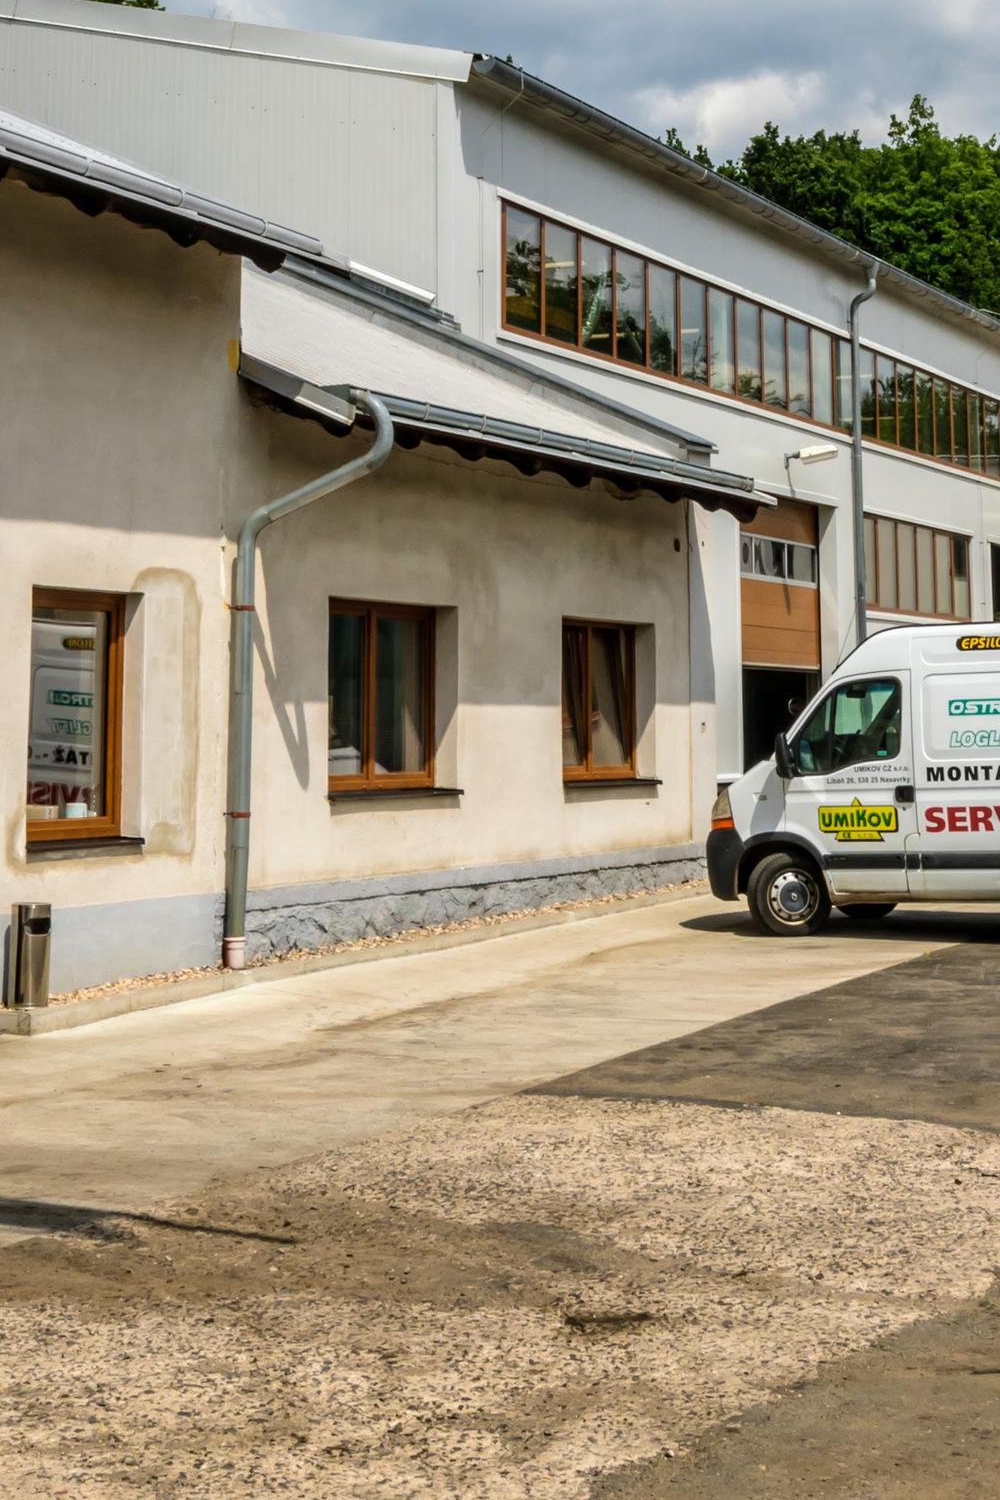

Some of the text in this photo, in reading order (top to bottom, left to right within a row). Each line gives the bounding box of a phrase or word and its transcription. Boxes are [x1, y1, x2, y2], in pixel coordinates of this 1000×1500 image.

[926, 766, 1000, 782] MONT
[821, 809, 892, 827] UMIKOV
[924, 805, 1000, 833] SER
